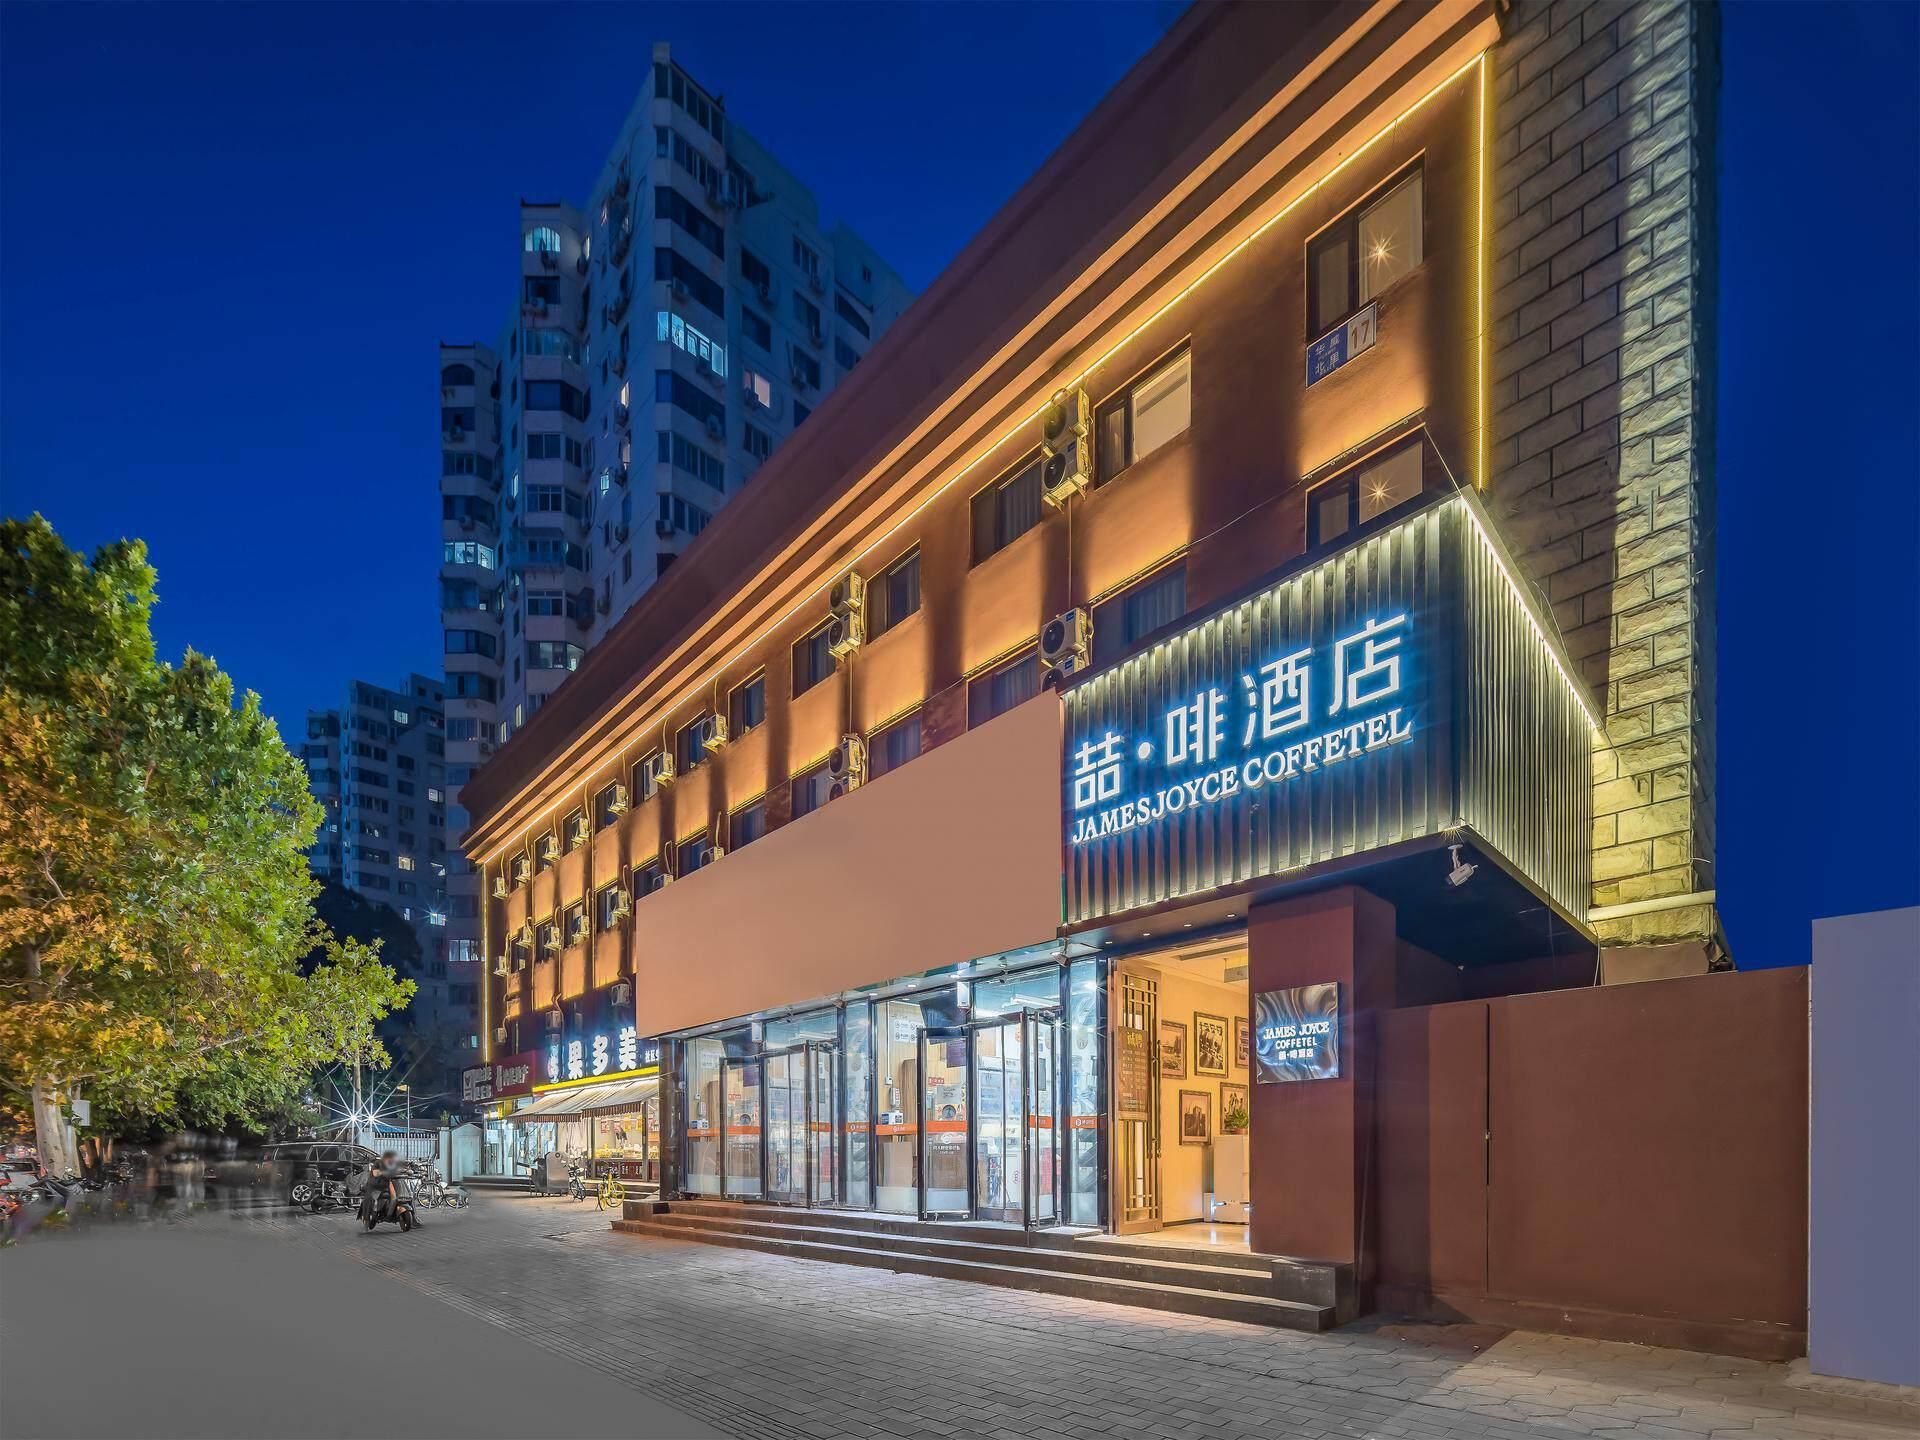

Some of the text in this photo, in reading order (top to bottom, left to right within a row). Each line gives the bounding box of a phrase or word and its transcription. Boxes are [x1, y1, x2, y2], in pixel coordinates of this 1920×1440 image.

[1351, 319, 1370, 350] 17
[1241, 708, 1414, 790] COFFETEL
[1263, 1021, 1330, 1040] JAMES JOYCE
[1275, 1036, 1318, 1050] COFFETEL
[567, 1025, 638, 1080] 果多美
